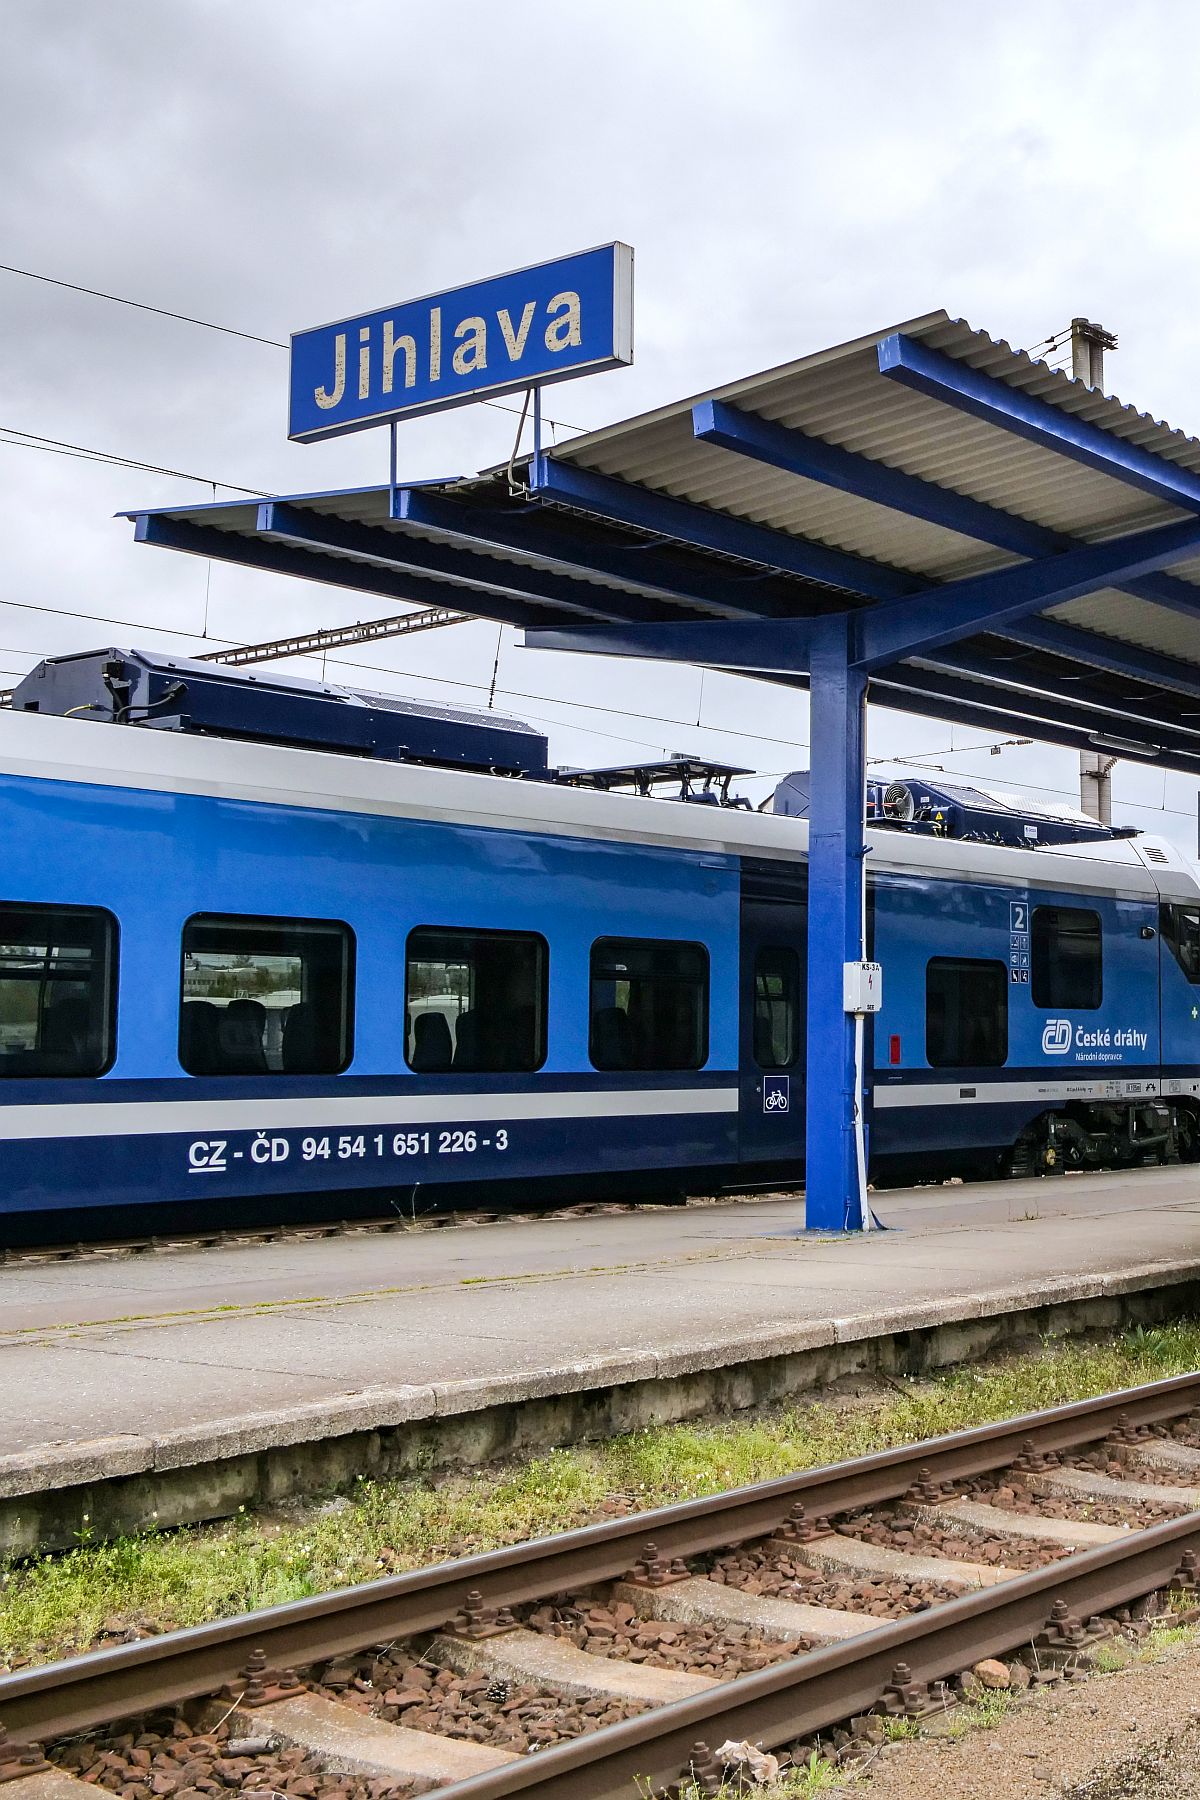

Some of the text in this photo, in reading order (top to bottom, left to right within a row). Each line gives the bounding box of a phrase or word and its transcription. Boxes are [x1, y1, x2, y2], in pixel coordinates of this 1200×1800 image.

[313, 291, 582, 410] Jihlava
[1014, 906, 1025, 929] 2
[1075, 1025, 1148, 1051] České dráhy
[1075, 1052, 1123, 1062] Národní dopravce
[188, 1140, 227, 1168] CZ
[250, 1131, 290, 1164] ČD
[302, 1137, 331, 1161] 94
[337, 1135, 366, 1159] 54
[373, 1134, 384, 1156] 1
[393, 1132, 430, 1156] 651
[438, 1130, 477, 1154] 226
[495, 1129, 508, 1151] 3
